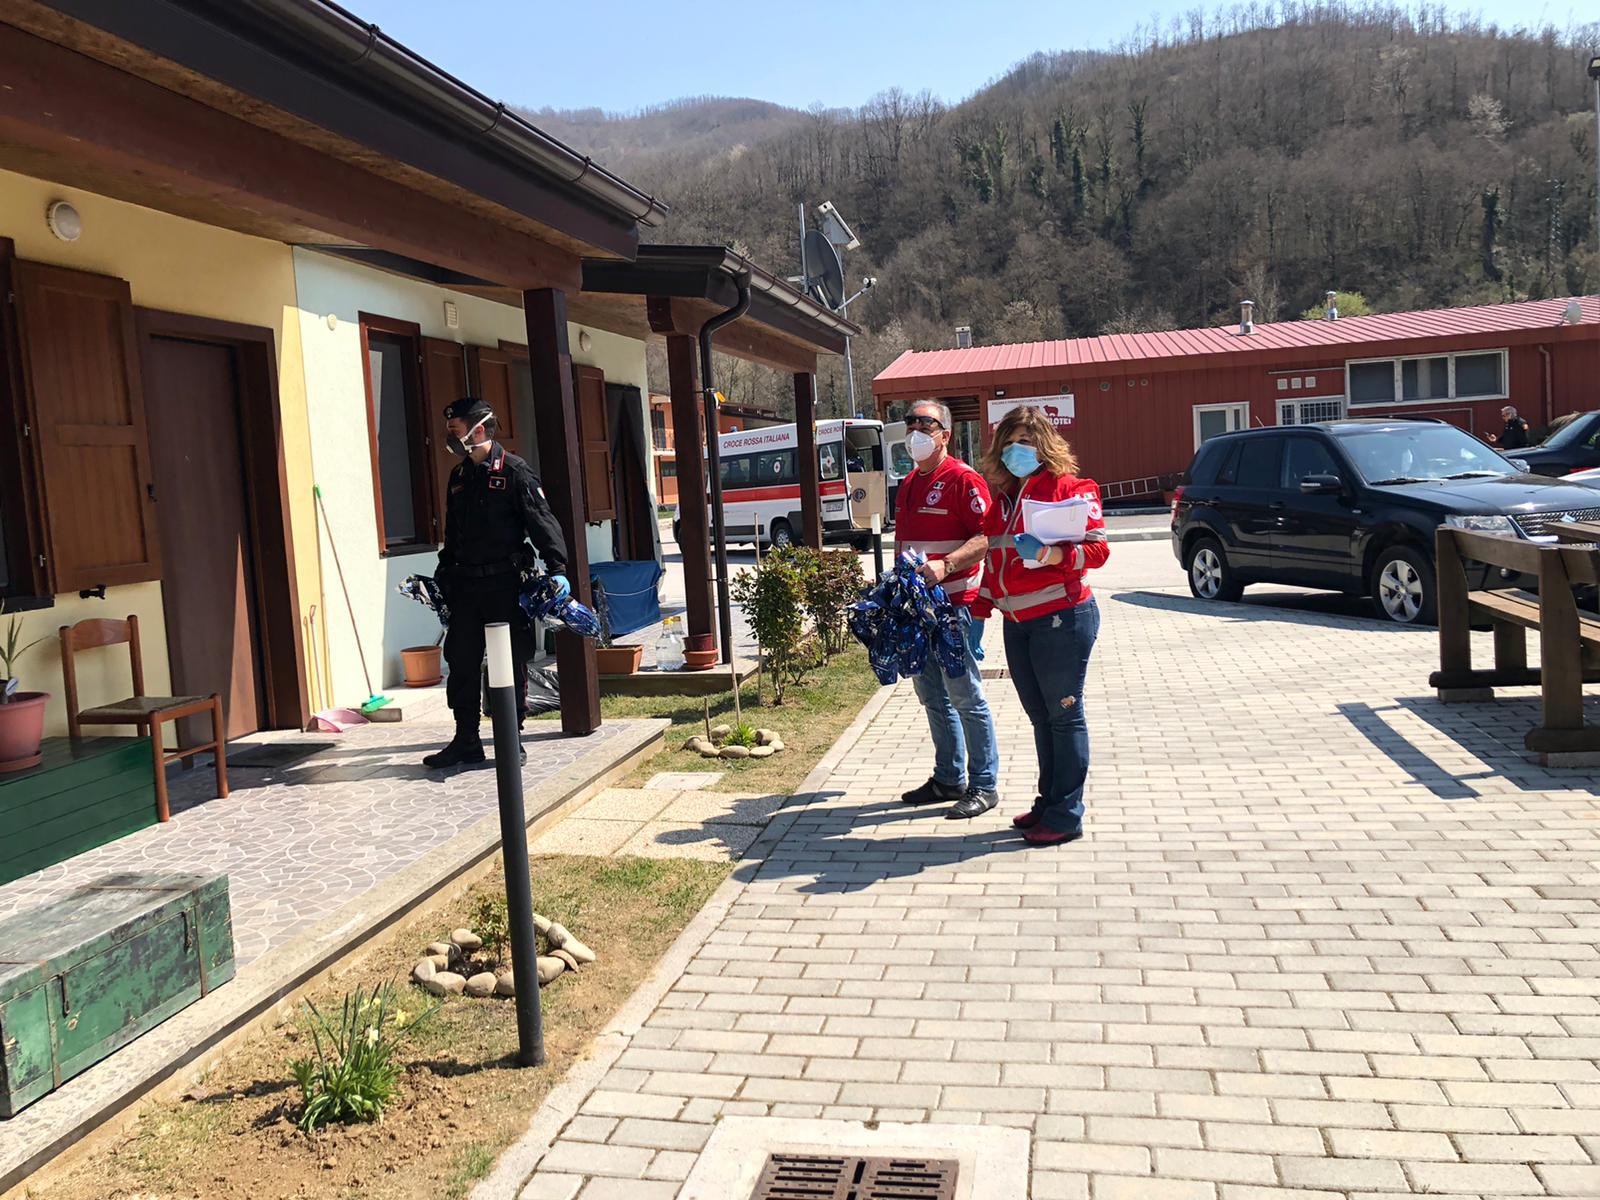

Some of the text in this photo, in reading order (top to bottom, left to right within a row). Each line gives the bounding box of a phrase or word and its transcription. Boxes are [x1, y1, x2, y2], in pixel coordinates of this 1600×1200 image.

[818, 427, 832, 435] CROCE
[723, 432, 790, 449] CROCE ROSSA ITALIANA
